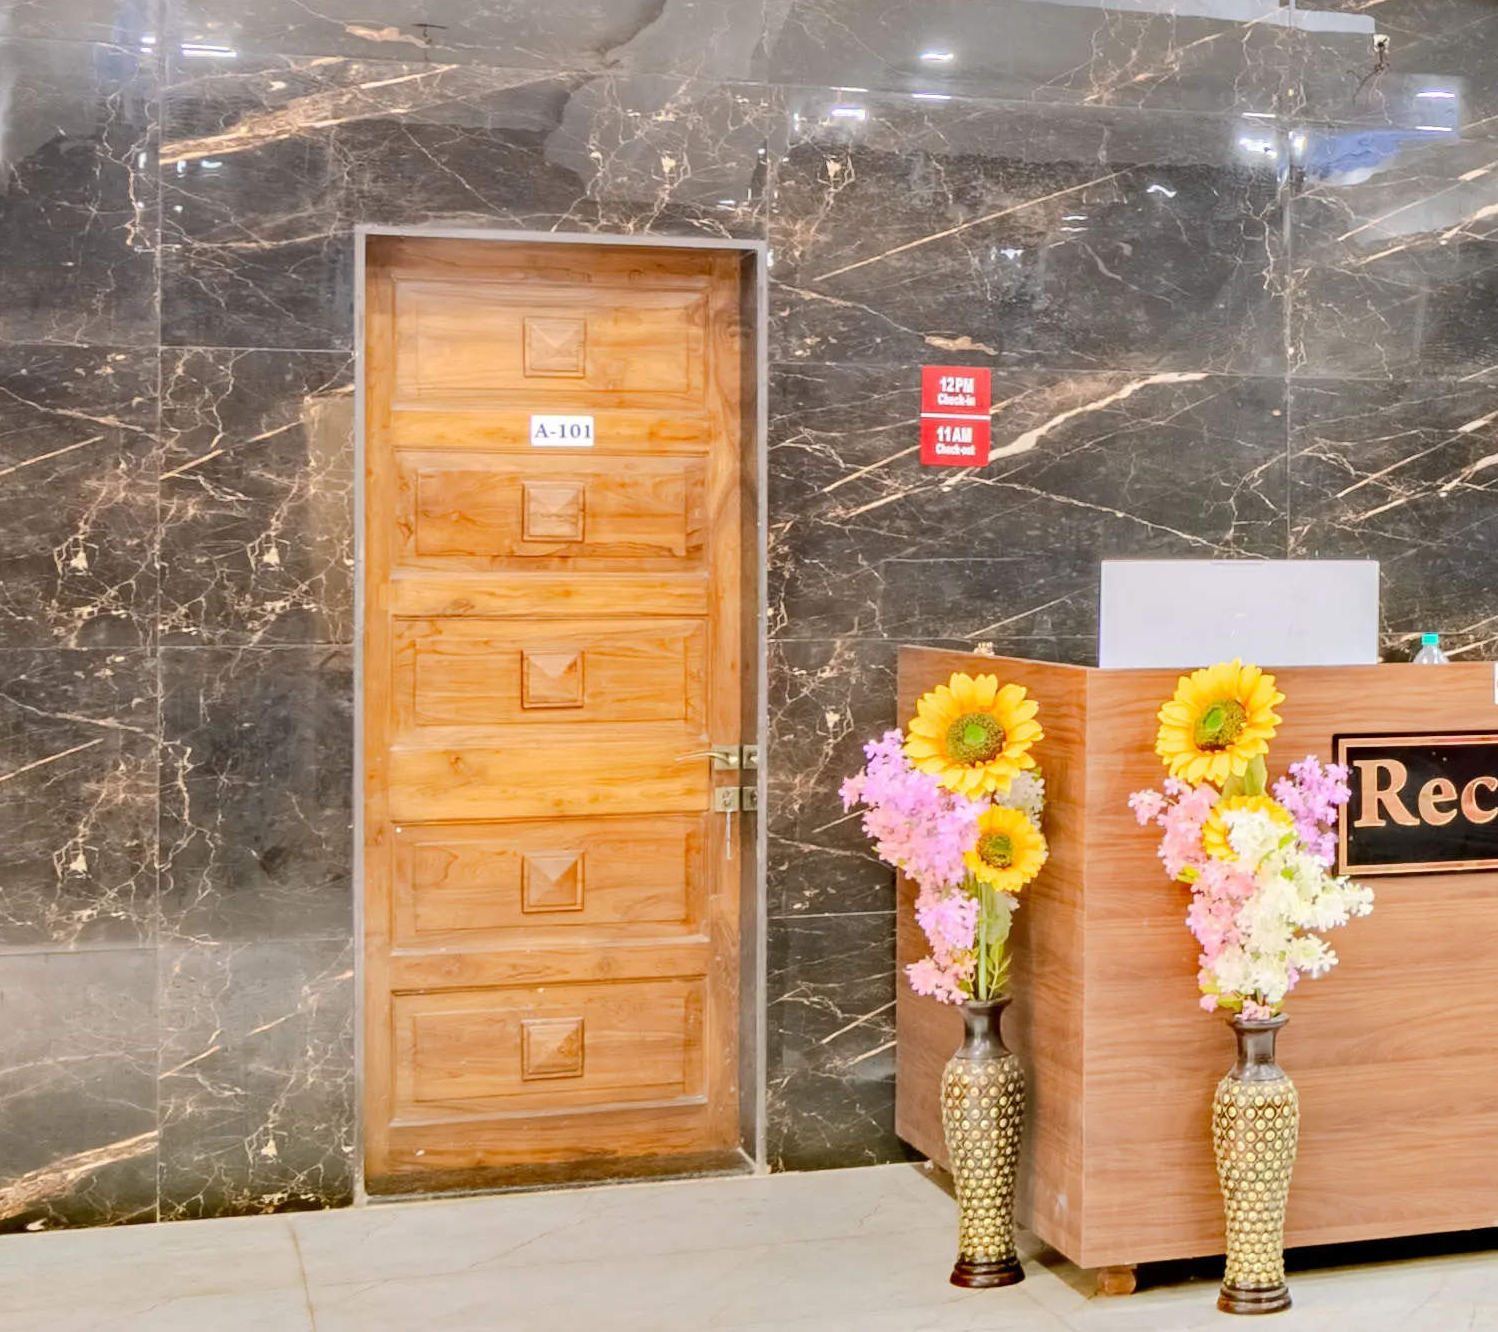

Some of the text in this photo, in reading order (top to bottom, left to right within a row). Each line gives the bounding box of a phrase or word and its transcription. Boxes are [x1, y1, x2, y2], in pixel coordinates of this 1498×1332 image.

[937, 392, 976, 407] Check-in
[534, 423, 591, 439] A-101
[935, 442, 976, 456] Check-out
